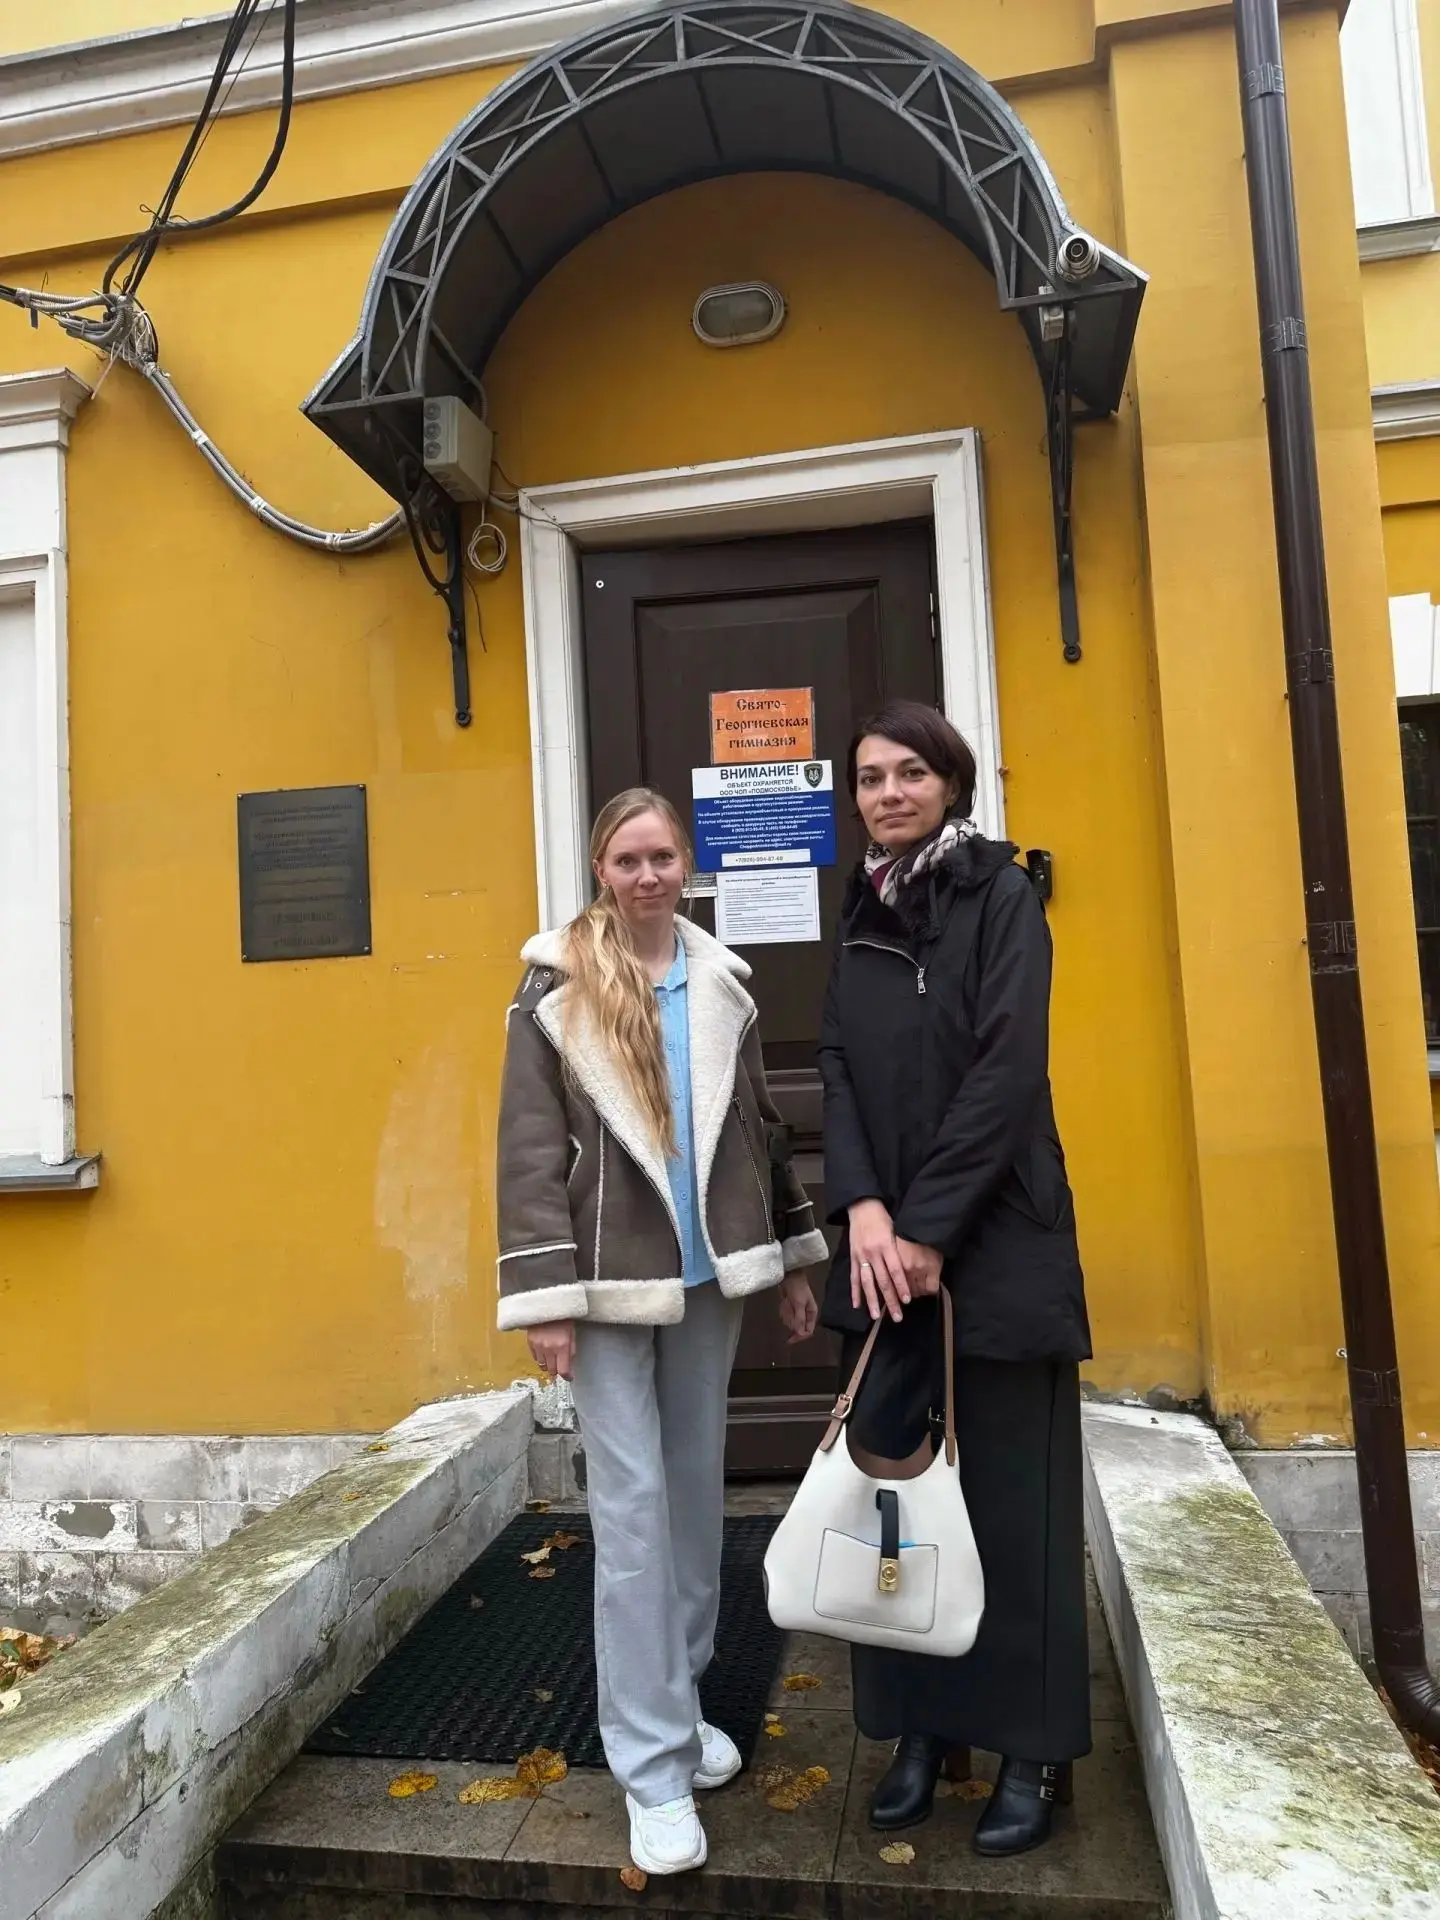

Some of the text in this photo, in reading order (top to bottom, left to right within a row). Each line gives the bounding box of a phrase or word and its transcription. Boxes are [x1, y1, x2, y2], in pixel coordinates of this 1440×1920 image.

[736, 698, 787, 711] Свято-
[715, 717, 809, 733] Георгиевская
[729, 736, 797, 749] гимназия
[720, 764, 799, 780] ВНИМАНИЕ!
[727, 779, 794, 789] ОБЪЕКТ ОХРАНЯЕТСЯ
[748, 785, 802, 794] «ПОДМОСКОВЬЕ»
